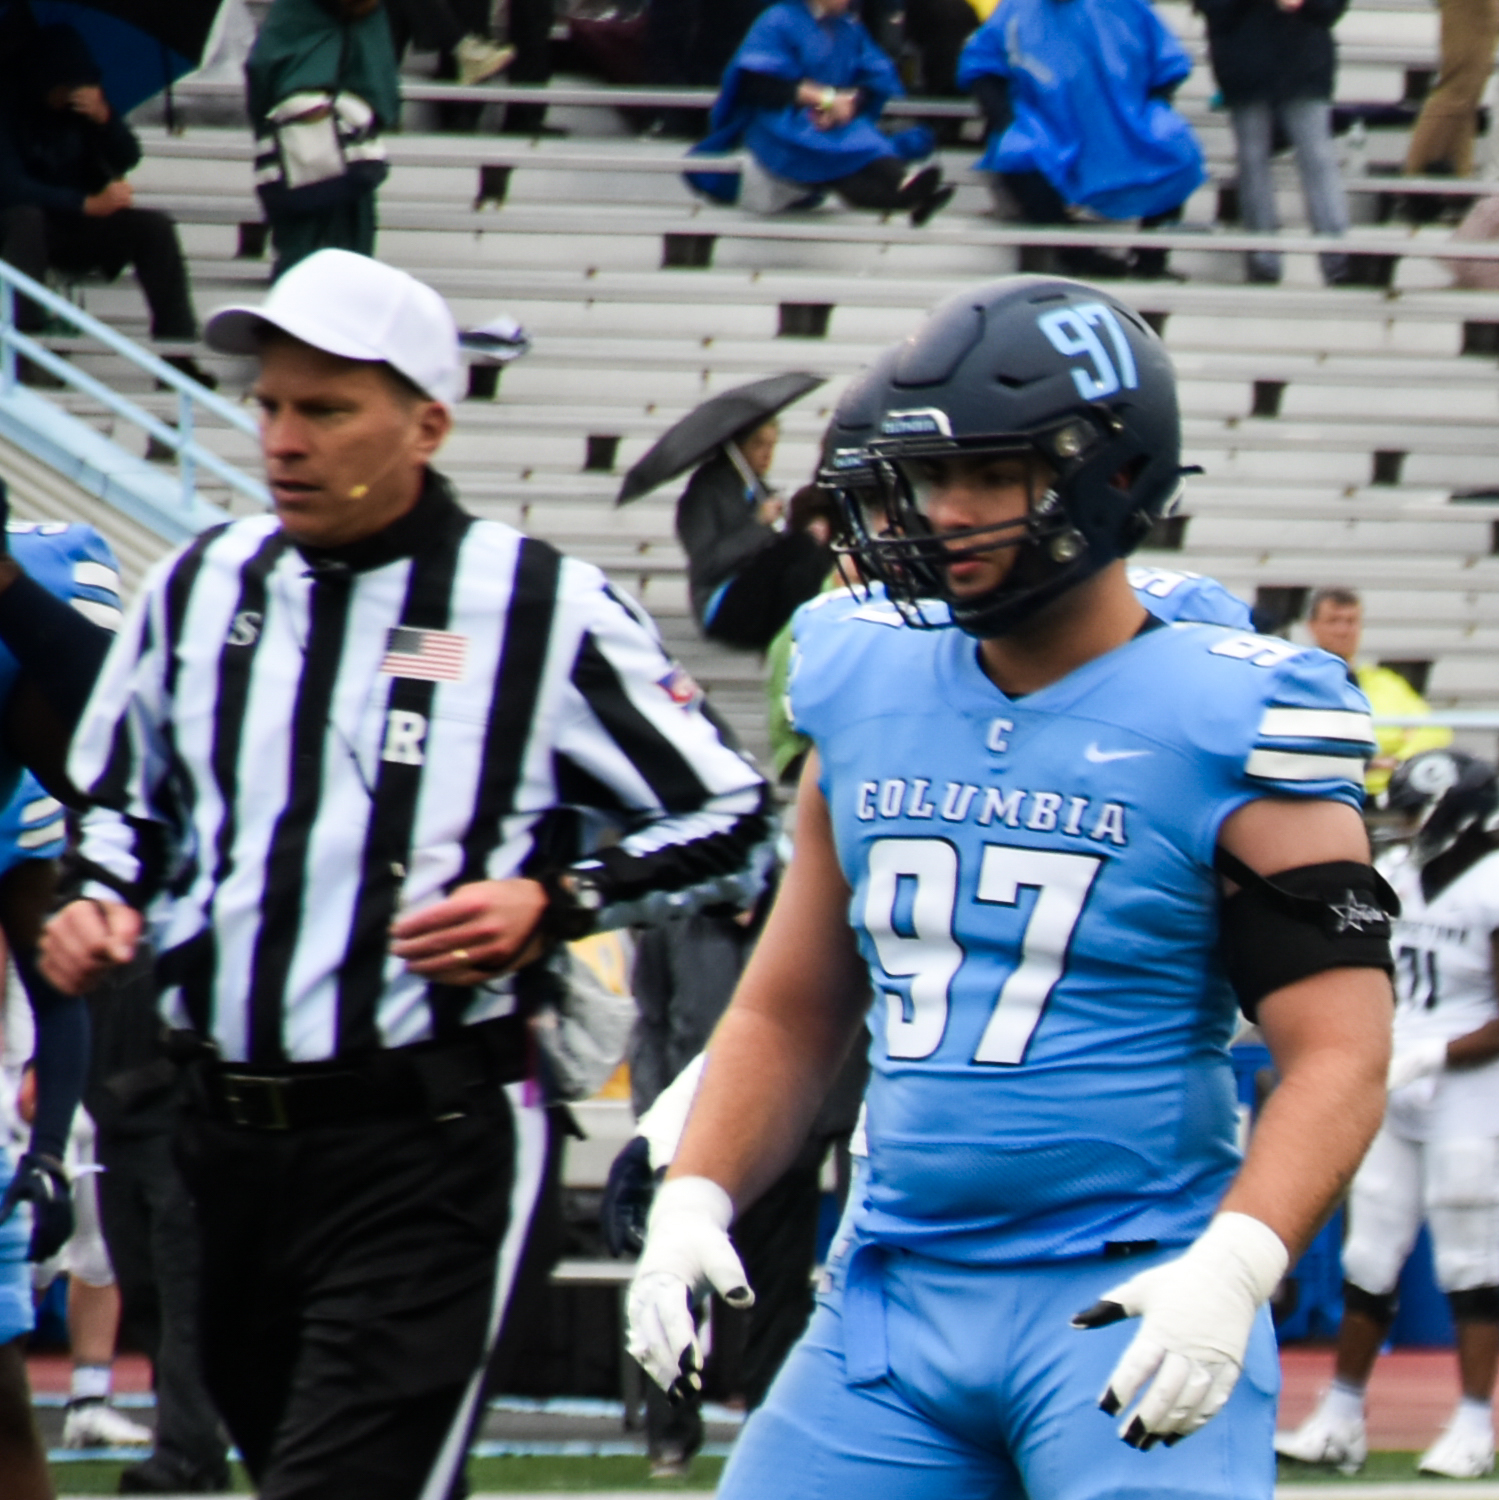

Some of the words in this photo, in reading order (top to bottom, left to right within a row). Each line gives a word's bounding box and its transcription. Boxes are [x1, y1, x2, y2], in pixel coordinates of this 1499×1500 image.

[1038, 302, 1139, 401] 97
[226, 611, 263, 647] S
[381, 708, 428, 767] R
[986, 717, 1014, 753] C
[856, 777, 1129, 846] COLUMBIA
[864, 835, 1108, 1067] 97
